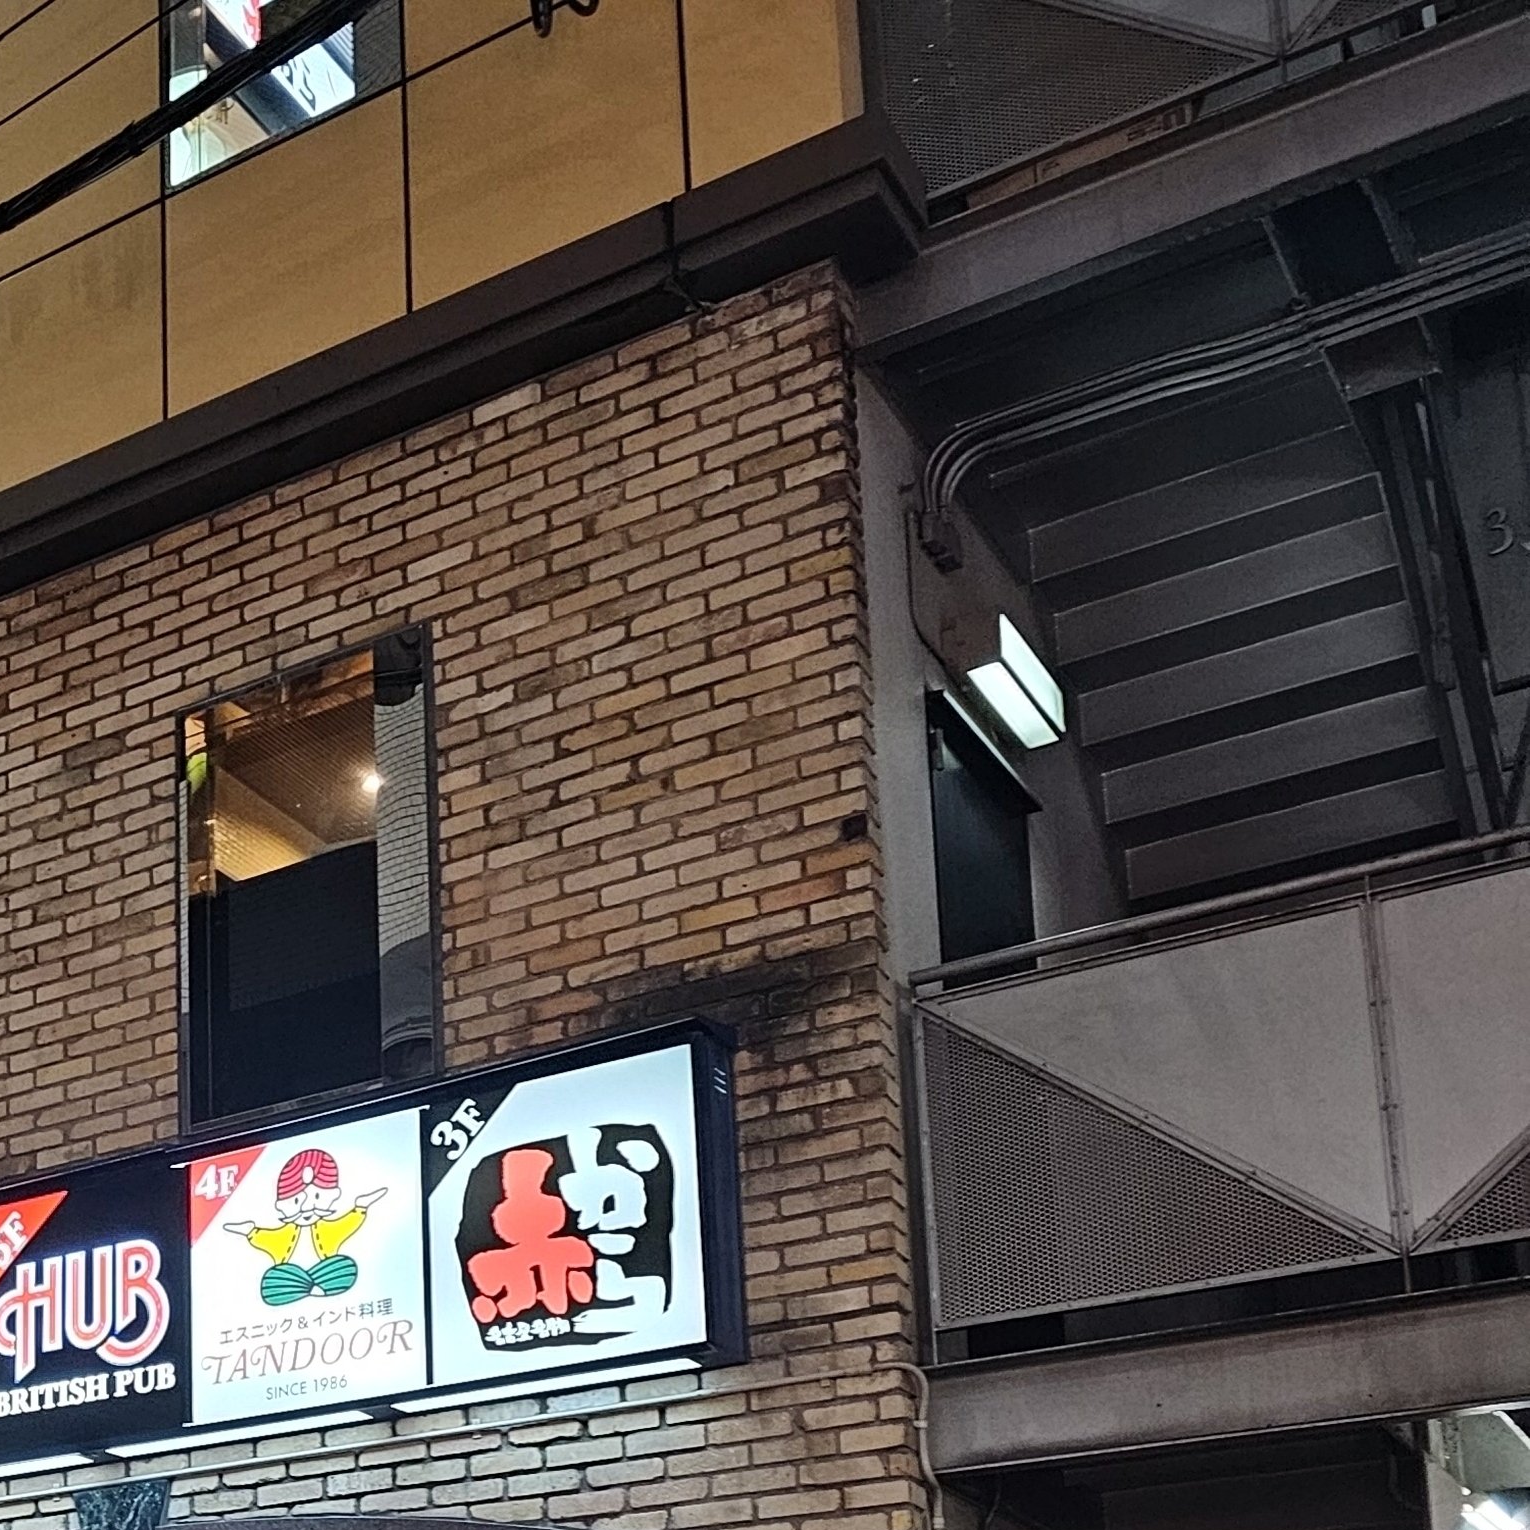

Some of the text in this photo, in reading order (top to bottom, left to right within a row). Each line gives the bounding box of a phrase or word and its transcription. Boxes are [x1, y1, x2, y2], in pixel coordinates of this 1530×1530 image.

[430, 1097, 486, 1161] 3F
[193, 1163, 240, 1201] 4F
[466, 1126, 670, 1334] 赤から
[219, 1297, 395, 1345] エスニック&インド料理
[200, 1319, 415, 1385] TANDOOR
[113, 1361, 177, 1396] PUB
[265, 1374, 348, 1401] SINCE 1986
